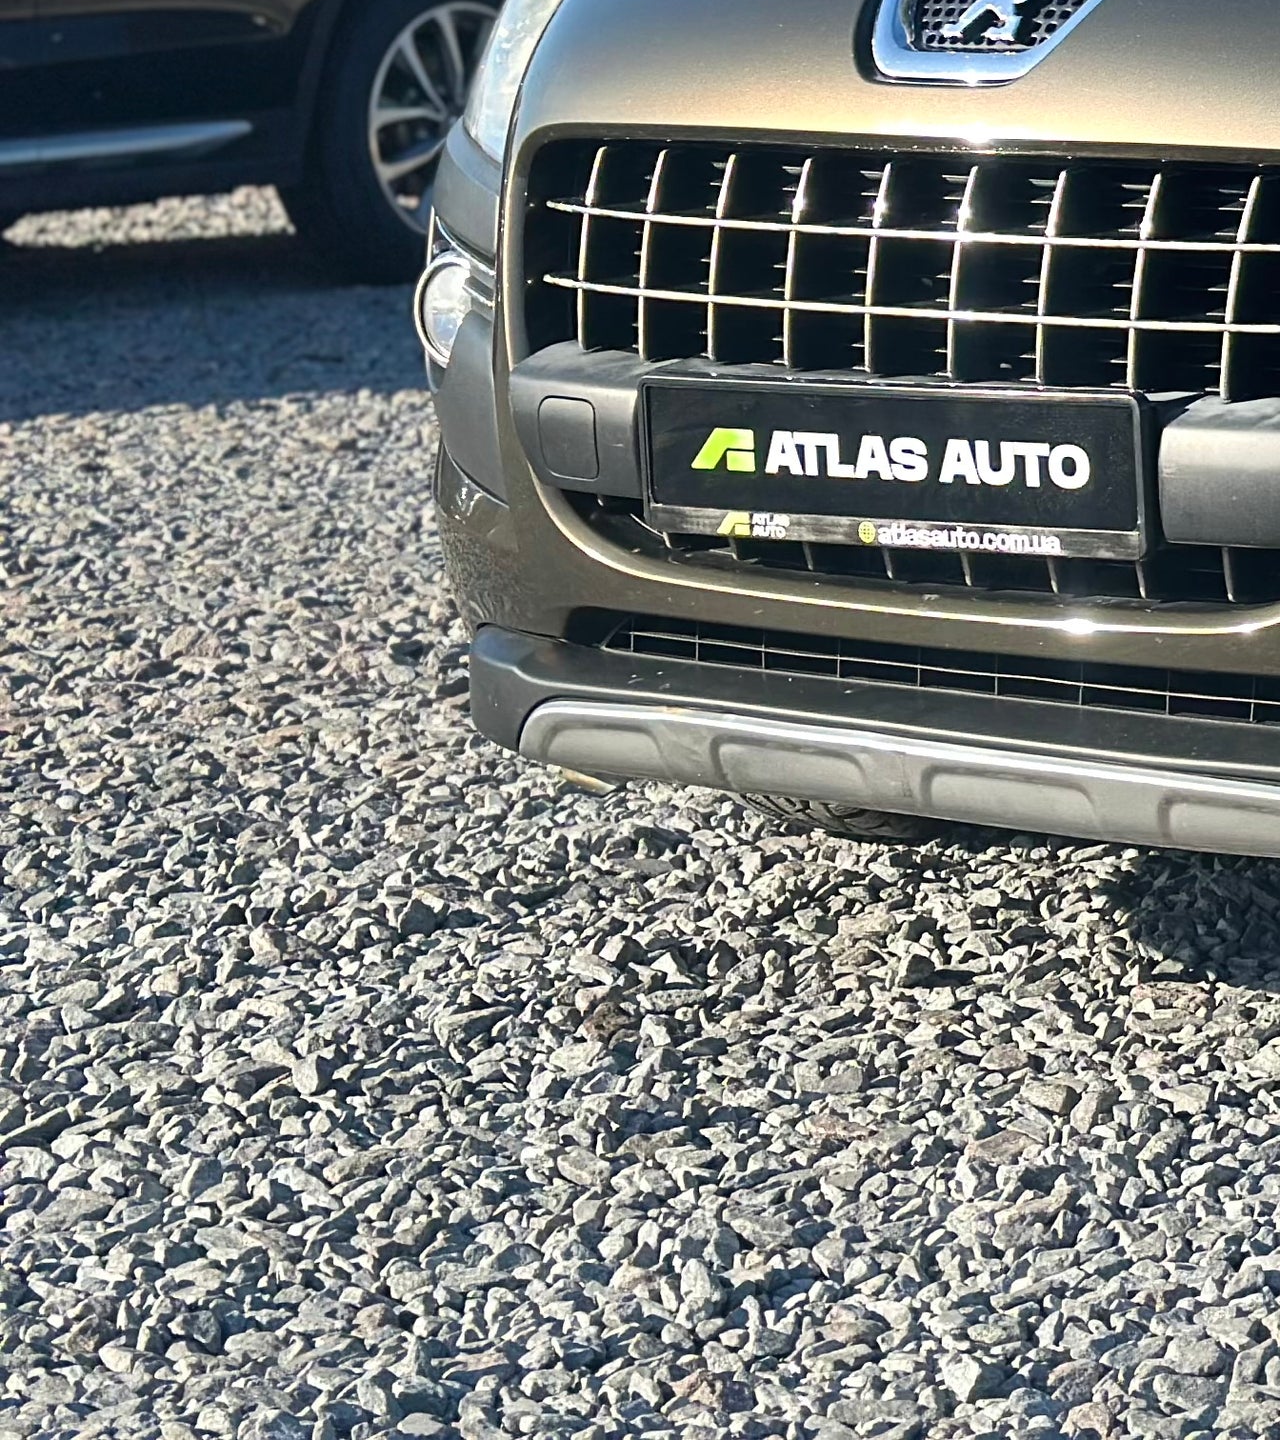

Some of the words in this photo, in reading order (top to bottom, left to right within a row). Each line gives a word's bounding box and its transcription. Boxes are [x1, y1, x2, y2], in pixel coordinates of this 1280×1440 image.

[765, 430, 928, 482] ATLAS
[939, 438, 1091, 490] AUTO
[752, 526, 786, 539] AUTO
[877, 522, 1062, 554] atlasauto.com.ua
